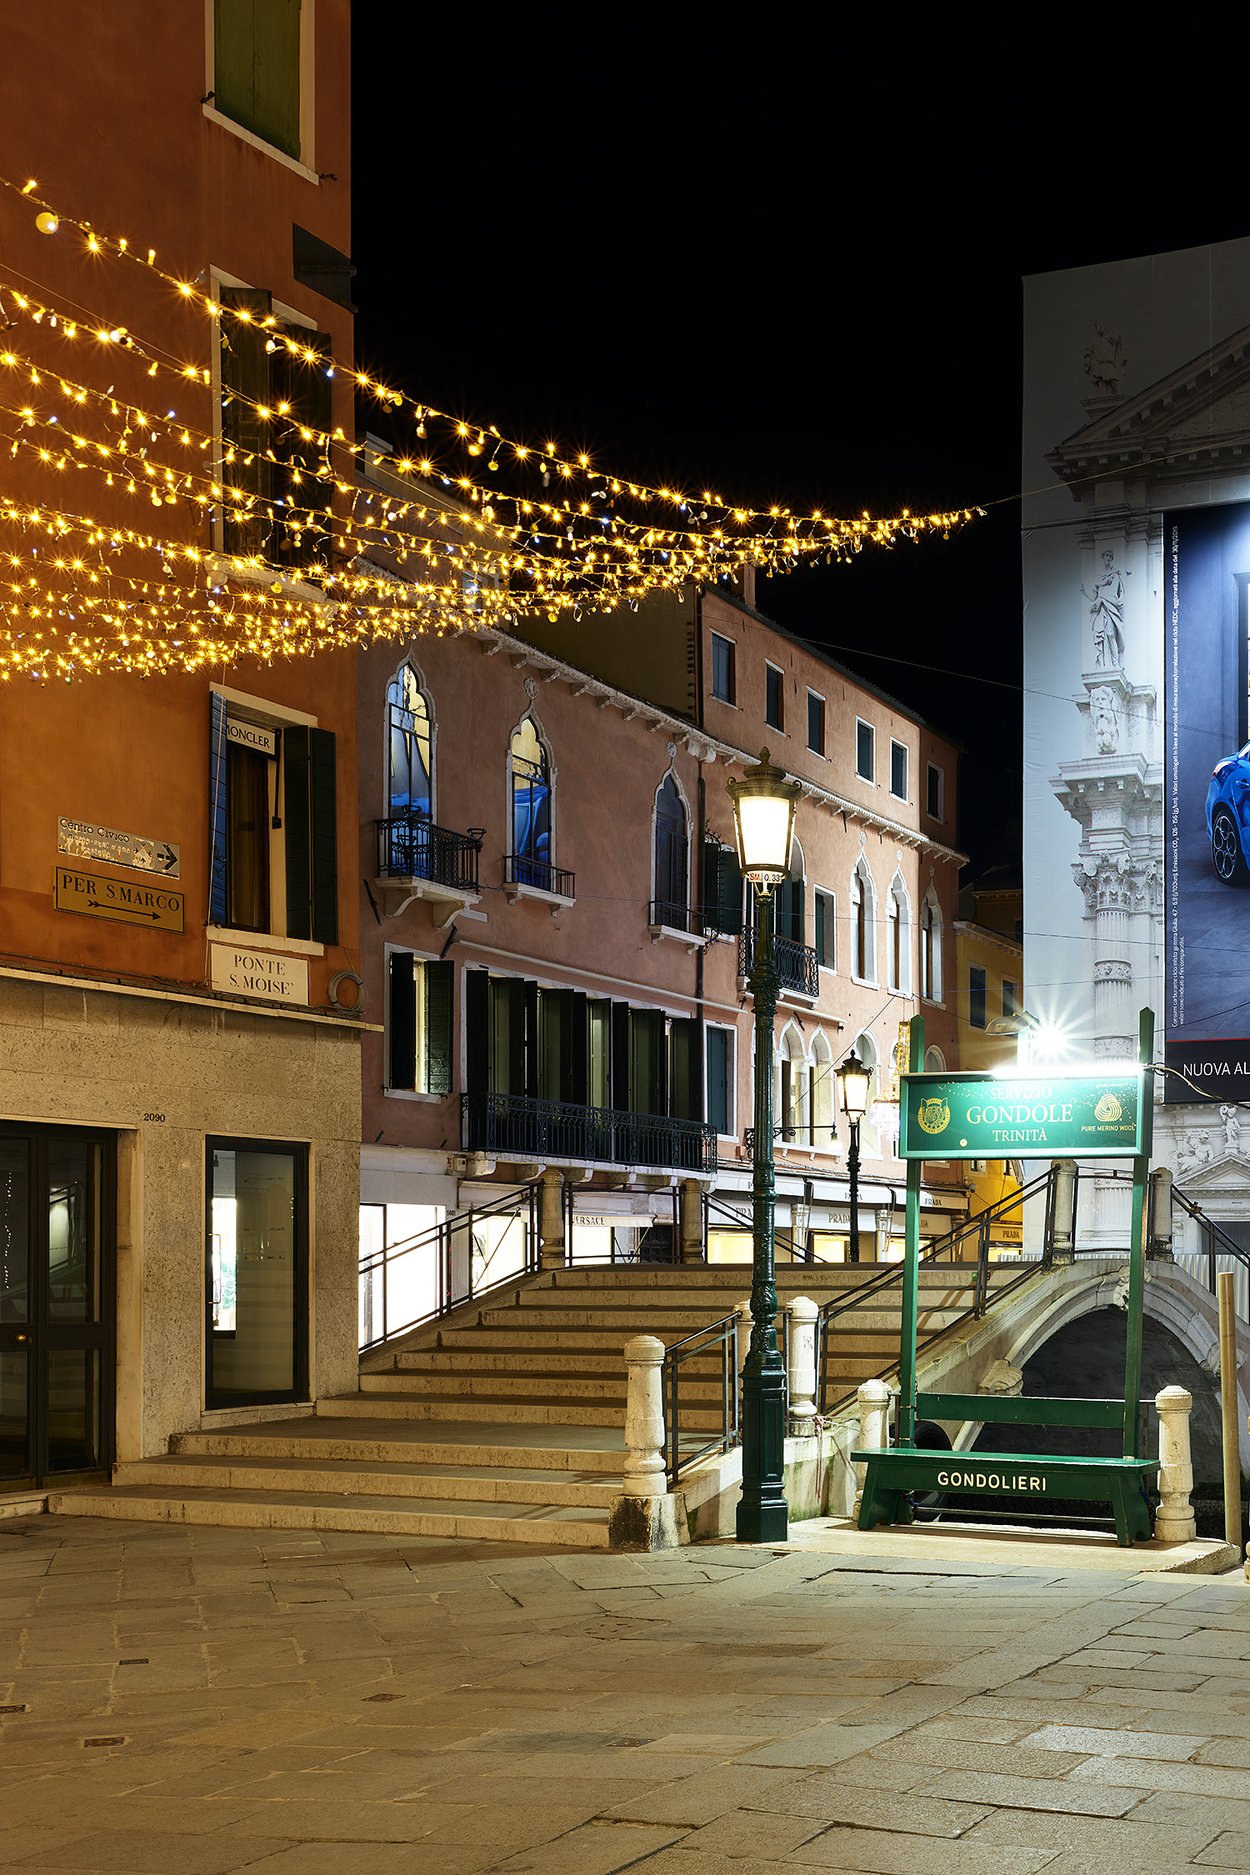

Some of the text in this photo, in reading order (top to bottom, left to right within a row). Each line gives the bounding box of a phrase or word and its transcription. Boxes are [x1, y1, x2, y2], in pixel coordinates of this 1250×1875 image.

[60, 818, 130, 843] Centro Civico
[63, 874, 180, 912] PER S.MARCO
[234, 954, 286, 976] PONTE
[229, 972, 240, 988] S.
[1182, 1061, 1232, 1077] NUOVA
[990, 1087, 1053, 1101] SERVIZIO
[143, 1112, 166, 1123] 2090
[966, 1102, 1073, 1125] GONDOLE
[992, 1127, 1048, 1142] TRINITÀ
[575, 1215, 605, 1226] ERSACE
[1002, 1230, 1020, 1240] PRADA
[937, 1471, 1047, 1492] GONDOLIERI
